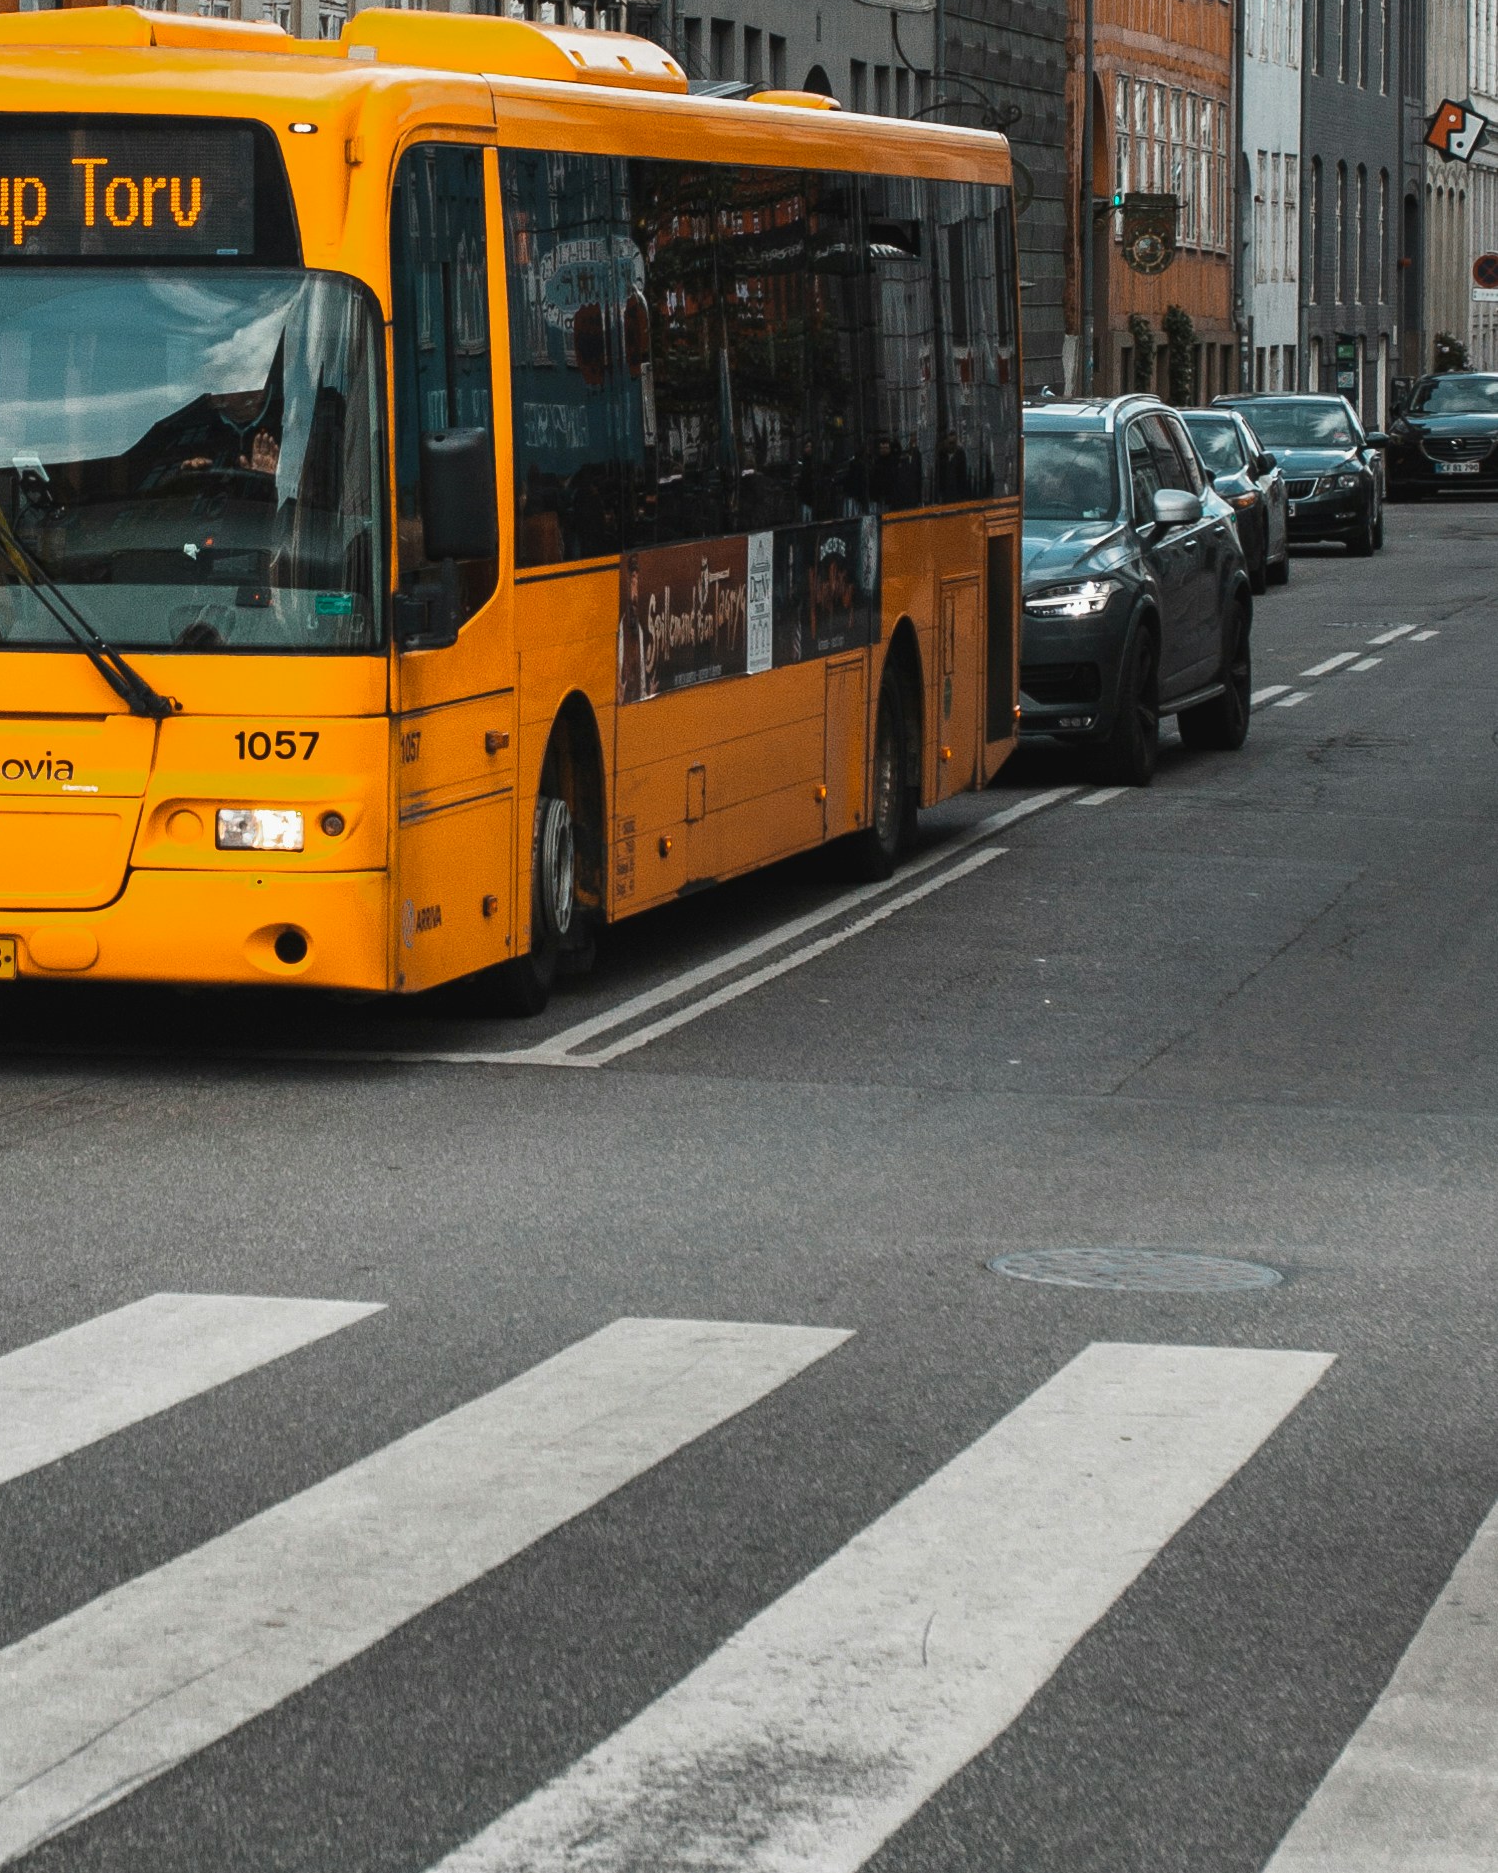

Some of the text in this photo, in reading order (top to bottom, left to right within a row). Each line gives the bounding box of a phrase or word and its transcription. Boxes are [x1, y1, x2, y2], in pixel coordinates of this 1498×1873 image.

[71, 158, 202, 227] Torv
[234, 731, 320, 761] 1057
[402, 730, 422, 765] 1057
[416, 904, 443, 934] ARRIVA
